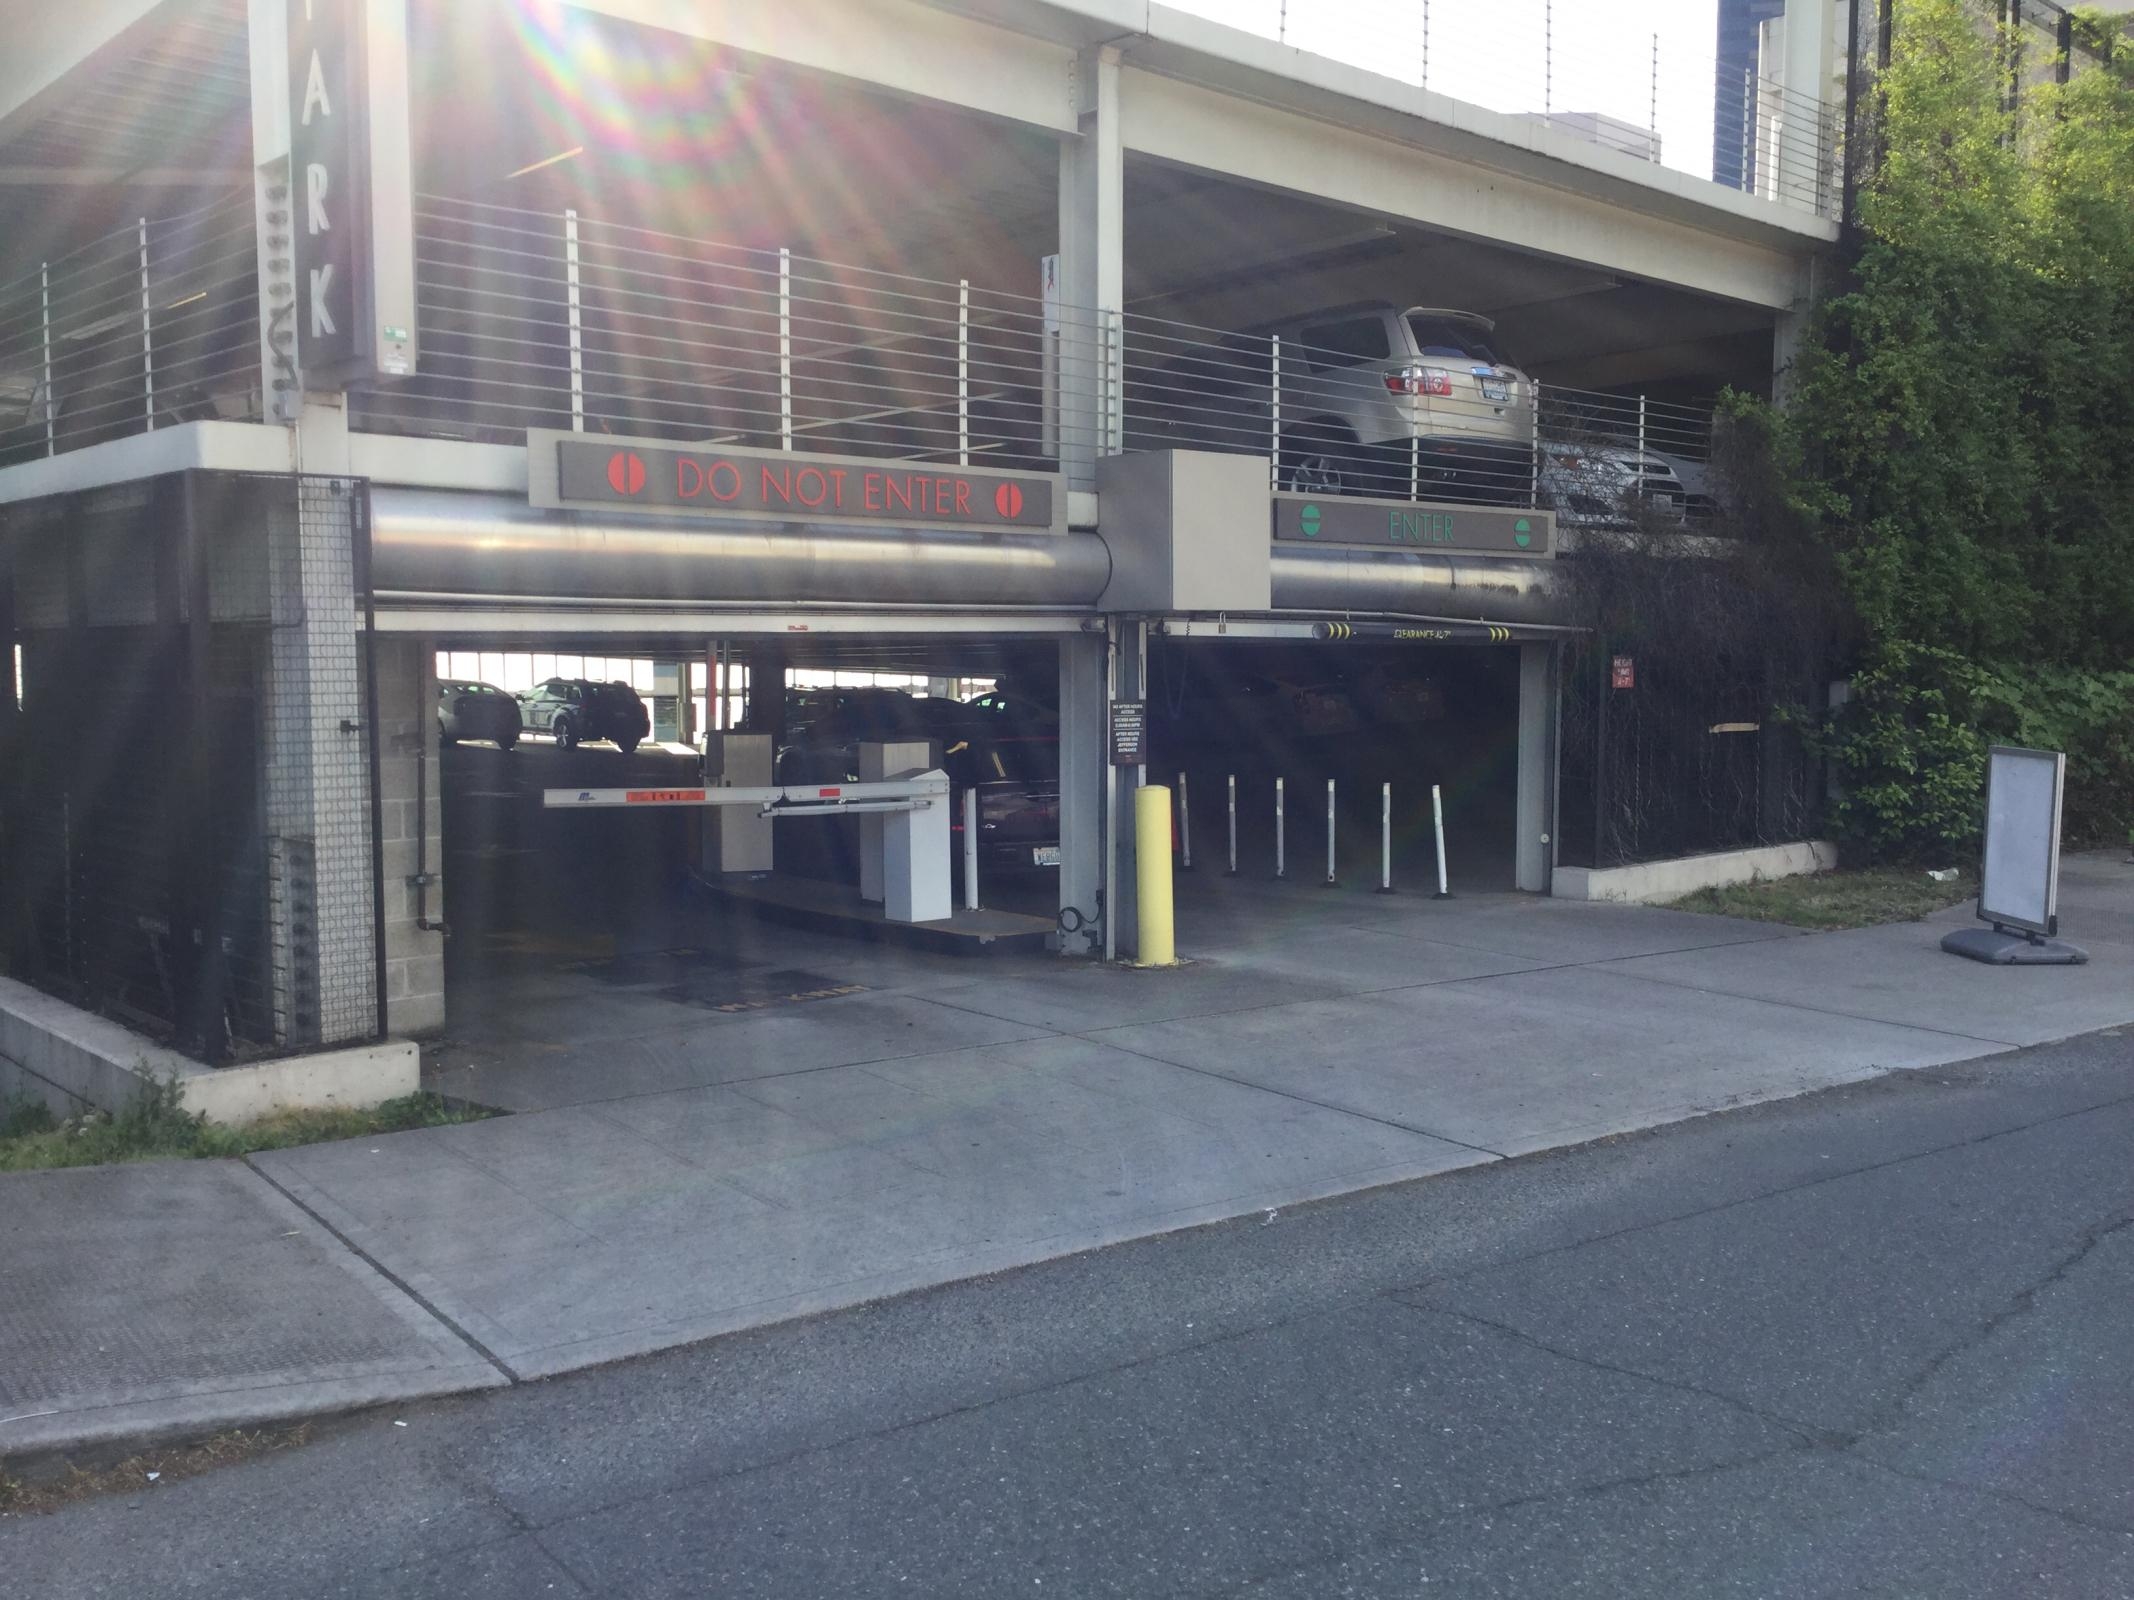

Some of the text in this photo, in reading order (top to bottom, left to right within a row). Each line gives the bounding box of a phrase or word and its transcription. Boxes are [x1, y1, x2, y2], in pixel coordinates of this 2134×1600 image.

[676, 457, 972, 515] DO NOT ENTER
[1389, 511, 1455, 543] ENTER
